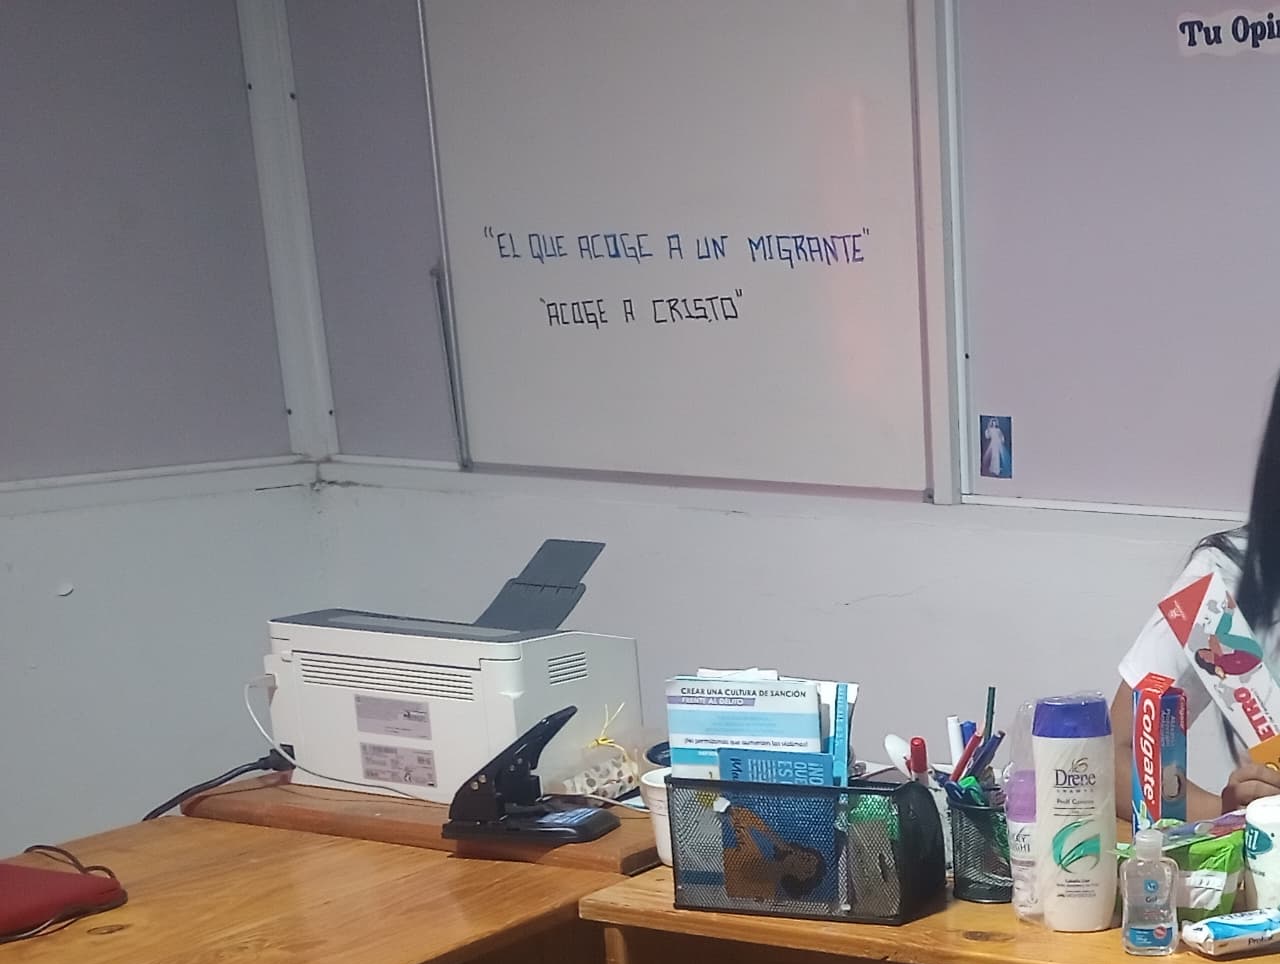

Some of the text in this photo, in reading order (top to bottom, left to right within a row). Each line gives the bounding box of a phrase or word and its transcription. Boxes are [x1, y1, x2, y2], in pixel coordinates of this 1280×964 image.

[1179, 20, 1222, 47] Tu
[528, 233, 568, 264] QUE
[578, 233, 653, 265] ACOGE
[668, 233, 684, 261] A
[697, 234, 728, 260] UN
[623, 299, 636, 325] A
[680, 687, 705, 695] CREAR
[706, 688, 723, 696] UNA
[725, 689, 758, 697] CULTURA
[1233, 687, 1276, 742] ETRO
[1139, 699, 1156, 804] Colgate
[1054, 768, 1097, 786] Drene
